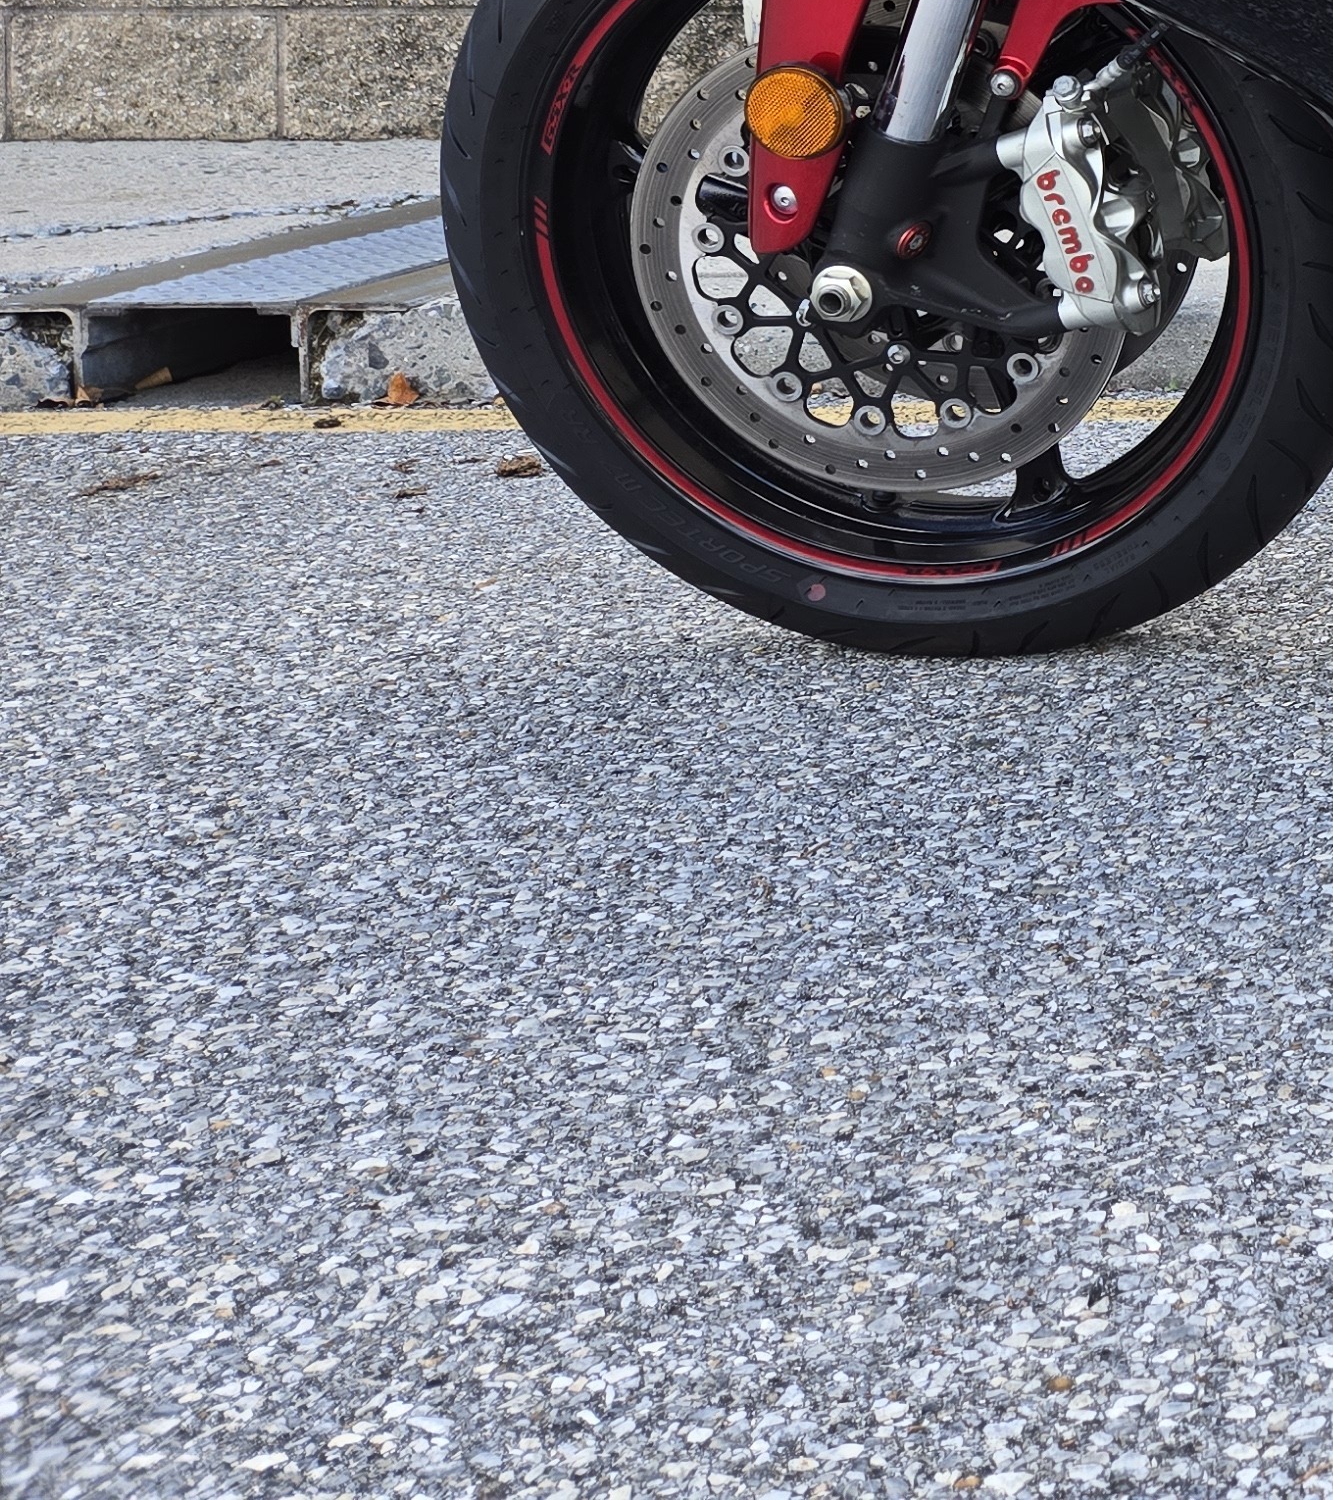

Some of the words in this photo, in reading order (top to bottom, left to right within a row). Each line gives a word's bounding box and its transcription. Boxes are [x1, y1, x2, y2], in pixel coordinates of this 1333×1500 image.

[1037, 169, 1095, 293] brembo
[1236, 301, 1284, 442] METZELER
[643, 498, 790, 585] SPORTEC
